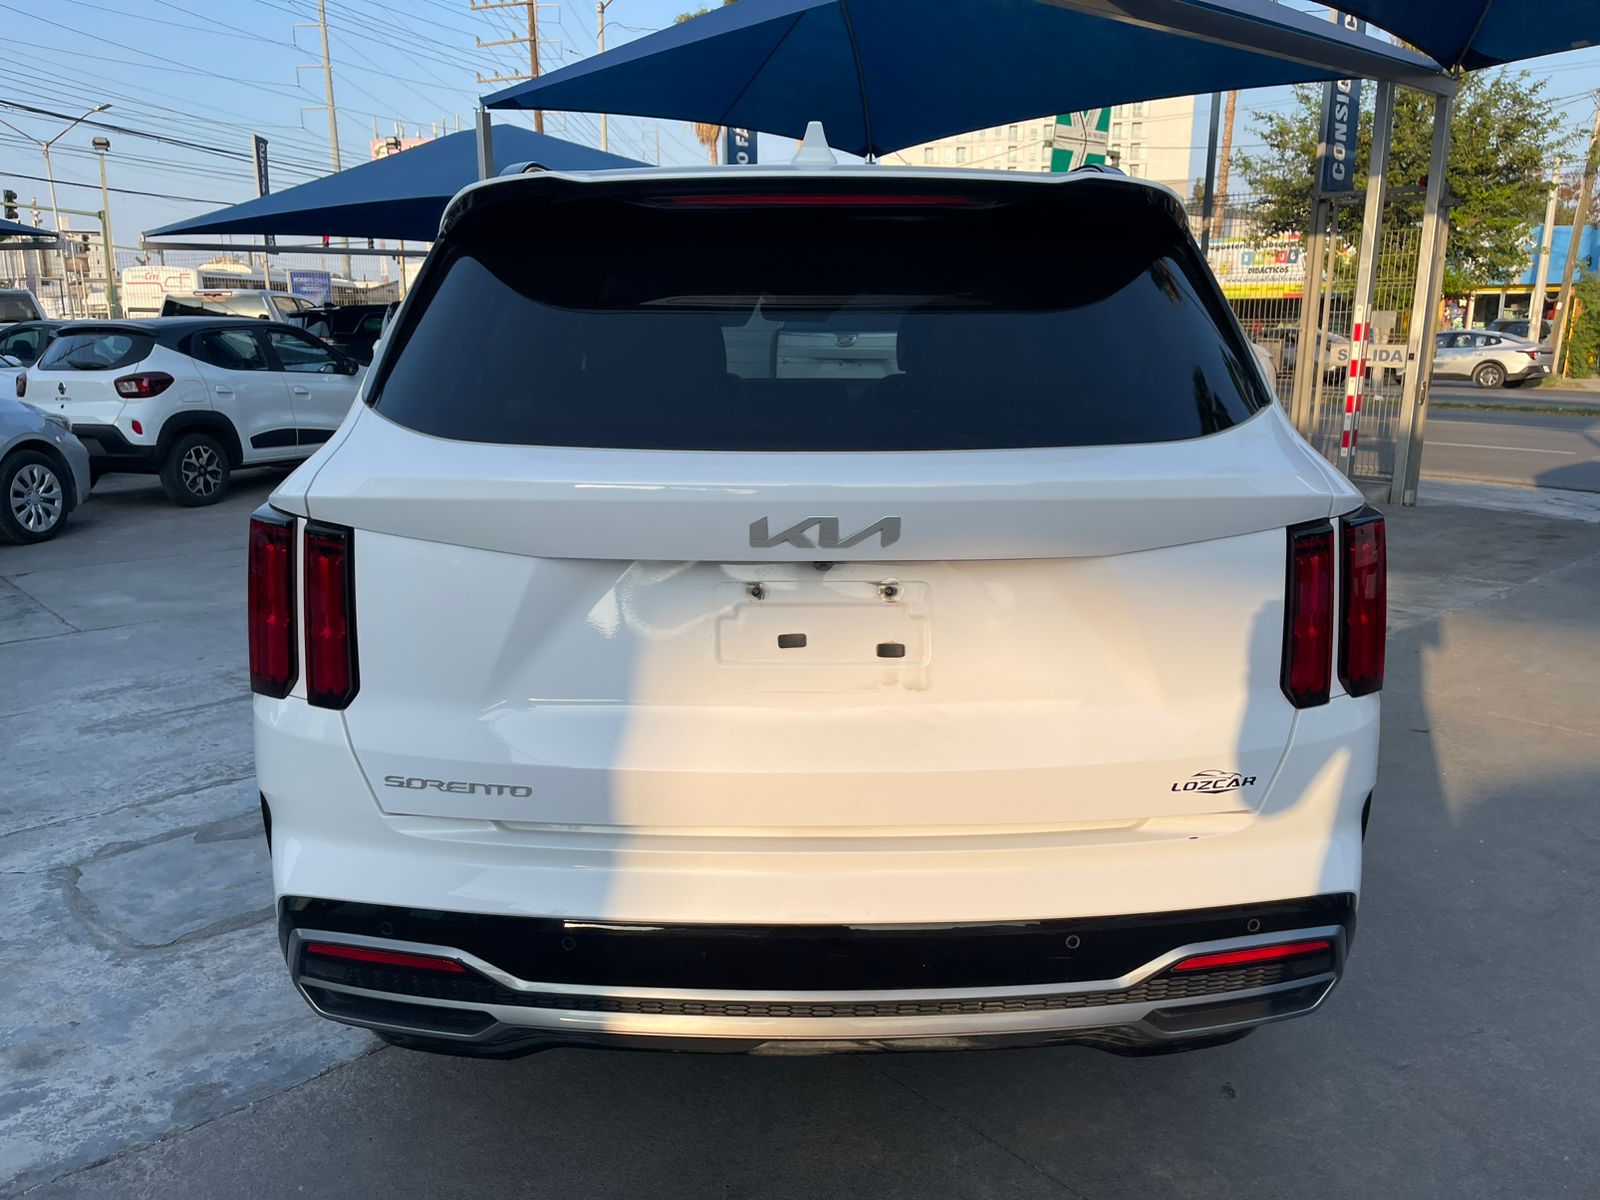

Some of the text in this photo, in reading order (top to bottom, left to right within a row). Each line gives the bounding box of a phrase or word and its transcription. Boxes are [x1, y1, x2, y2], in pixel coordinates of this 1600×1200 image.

[1333, 80, 1351, 181] CONSIG
[1337, 349, 1403, 363] SIDA
[749, 516, 902, 549] KIA
[384, 775, 533, 798] SORENTO
[1171, 776, 1257, 792] LOZCAR
